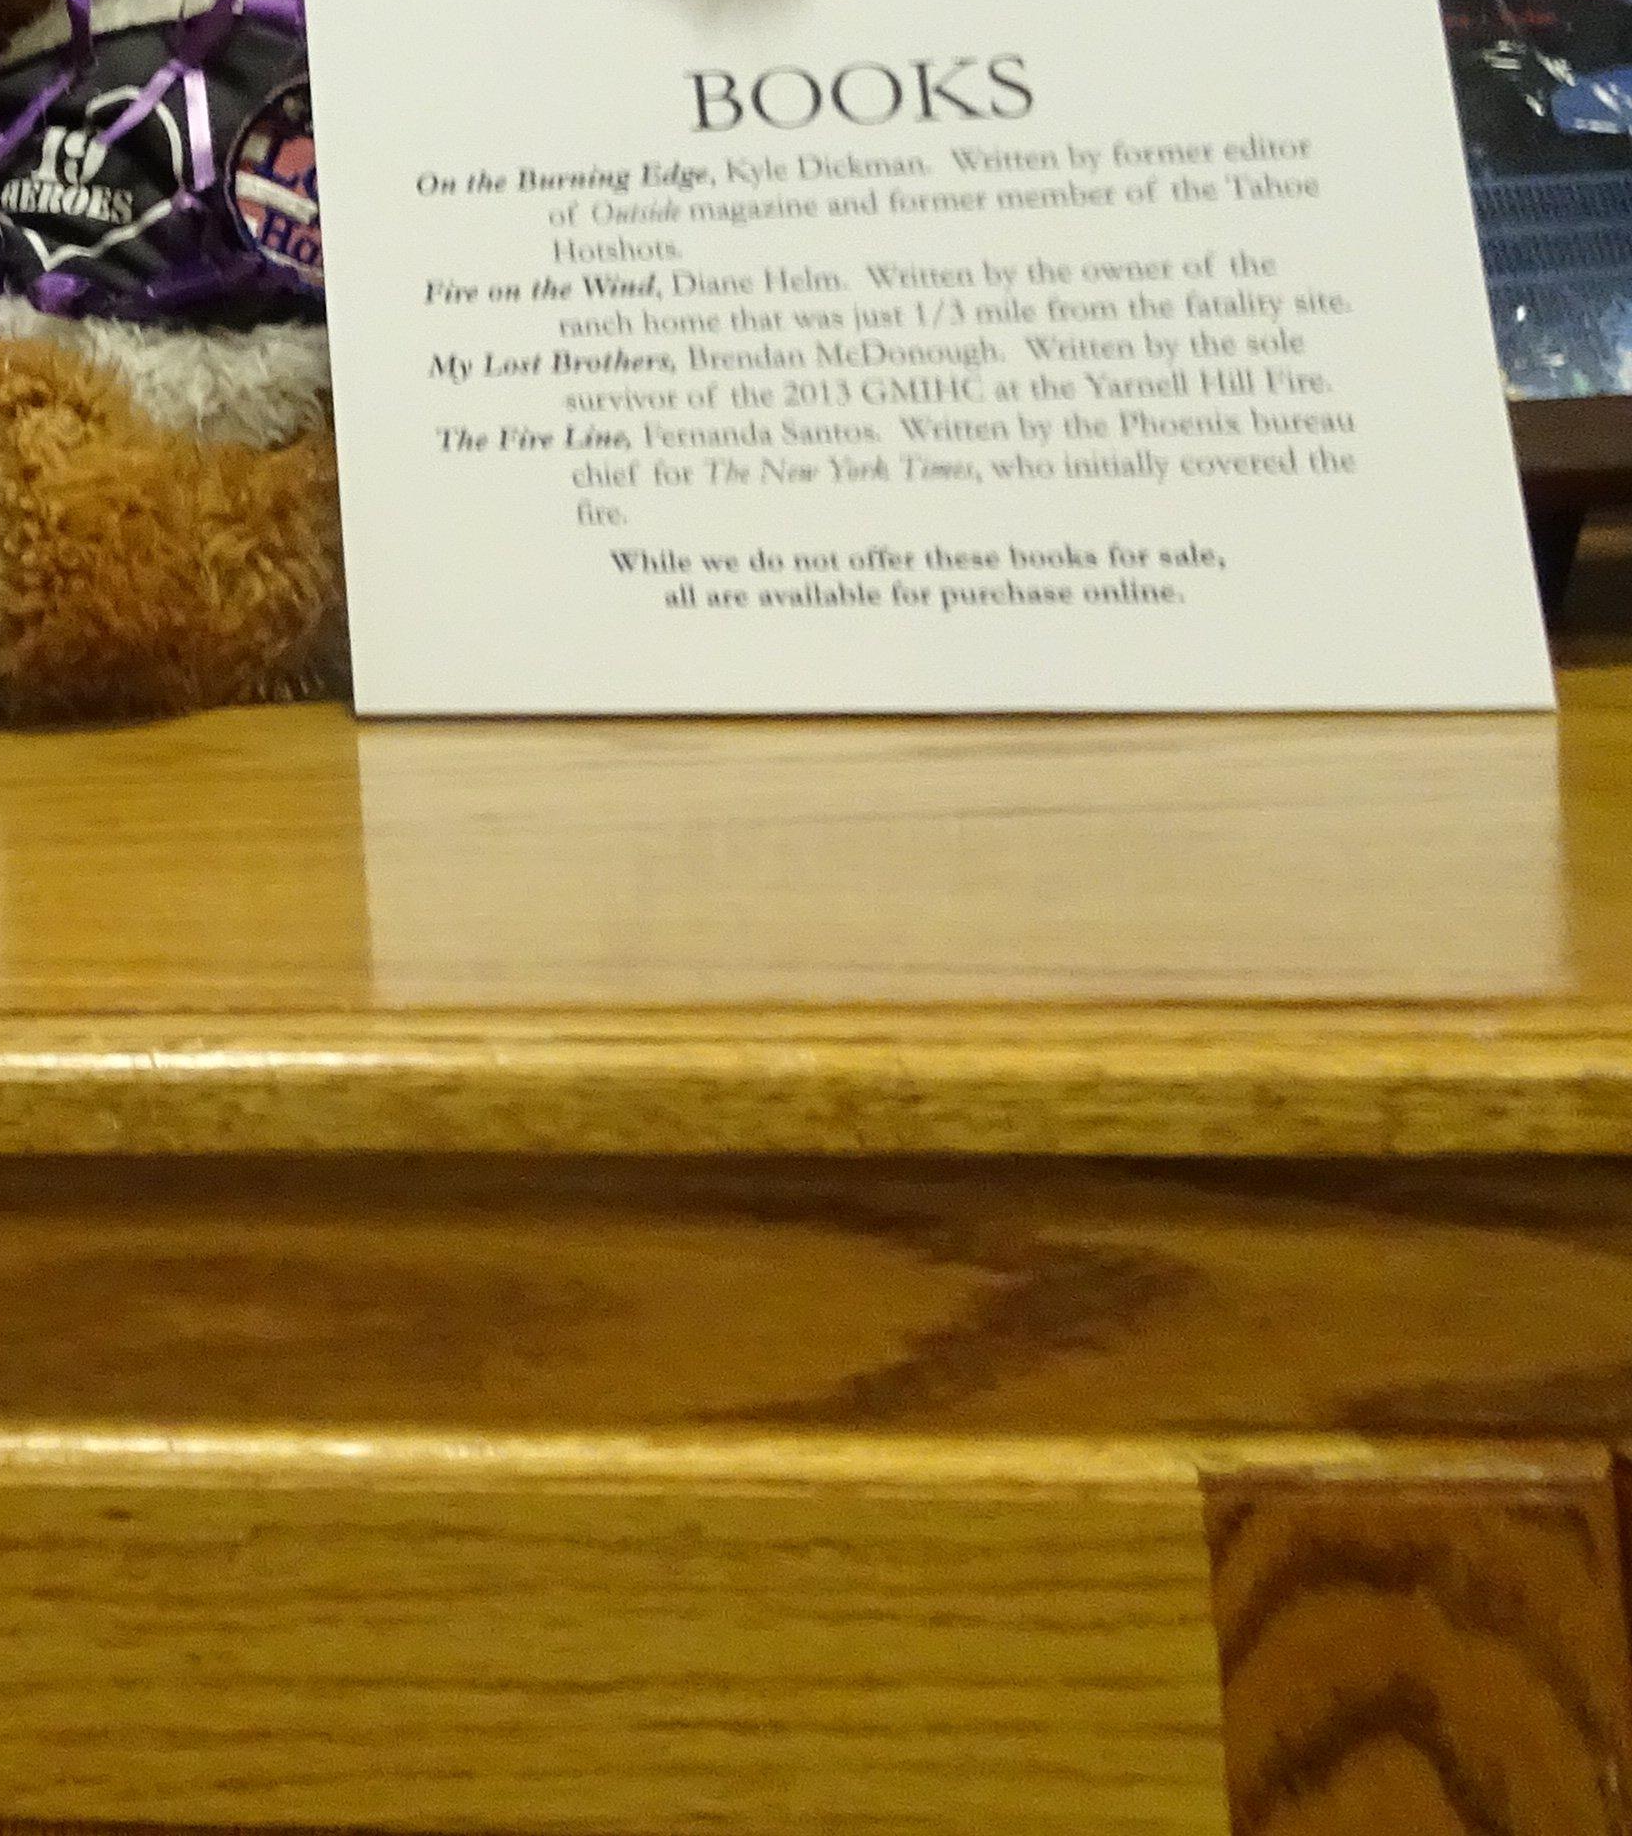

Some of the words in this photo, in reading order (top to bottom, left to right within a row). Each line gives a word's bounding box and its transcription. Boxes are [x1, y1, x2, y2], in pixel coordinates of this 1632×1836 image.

[682, 52, 1039, 133] BOOKS
[413, 169, 458, 199] On
[464, 167, 508, 196] the
[514, 162, 633, 200] Burning
[638, 158, 717, 194] Edge,
[724, 155, 789, 191] Kyle
[796, 148, 930, 182] Dickman.
[949, 143, 1059, 176] Written
[1065, 141, 1104, 177] by
[1110, 136, 1215, 169] former
[1220, 132, 1312, 164] editor
[550, 232, 682, 265] Hotshots.
[421, 277, 480, 307] Fire
[486, 284, 522, 305] on
[528, 274, 574, 303] the
[580, 270, 663, 304] Wind,
[670, 267, 754, 298] Diane
[762, 264, 845, 295] Helm.
[865, 259, 975, 292] Written
[981, 258, 1019, 293] by
[1024, 256, 1073, 286] the
[1079, 261, 1174, 285] owner
[1179, 251, 1216, 281] of
[1226, 248, 1278, 280] the
[425, 351, 475, 386] My
[481, 349, 544, 379] Lost
[548, 345, 678, 380] Brothers,
[686, 341, 806, 373] Brendan
[814, 335, 1004, 375] McDonough.
[1023, 331, 1136, 363] Written
[1142, 329, 1181, 366] by
[1187, 328, 1238, 359] the
[1243, 326, 1306, 357] sole
[572, 496, 627, 526] fire.
[608, 544, 693, 575] While
[699, 553, 740, 573] we
[746, 543, 786, 573] do
[790, 544, 840, 572] not
[845, 541, 917, 572] offer
[921, 540, 1002, 571] these
[1006, 538, 1100, 570] books
[1105, 537, 1151, 568] for
[1155, 536, 1227, 571] sale,
[661, 579, 698, 609] all
[704, 588, 750, 609] are
[755, 577, 883, 608] available
[888, 576, 932, 607] for
[936, 575, 1075, 612] purchase
[1079, 573, 1189, 605] online.
